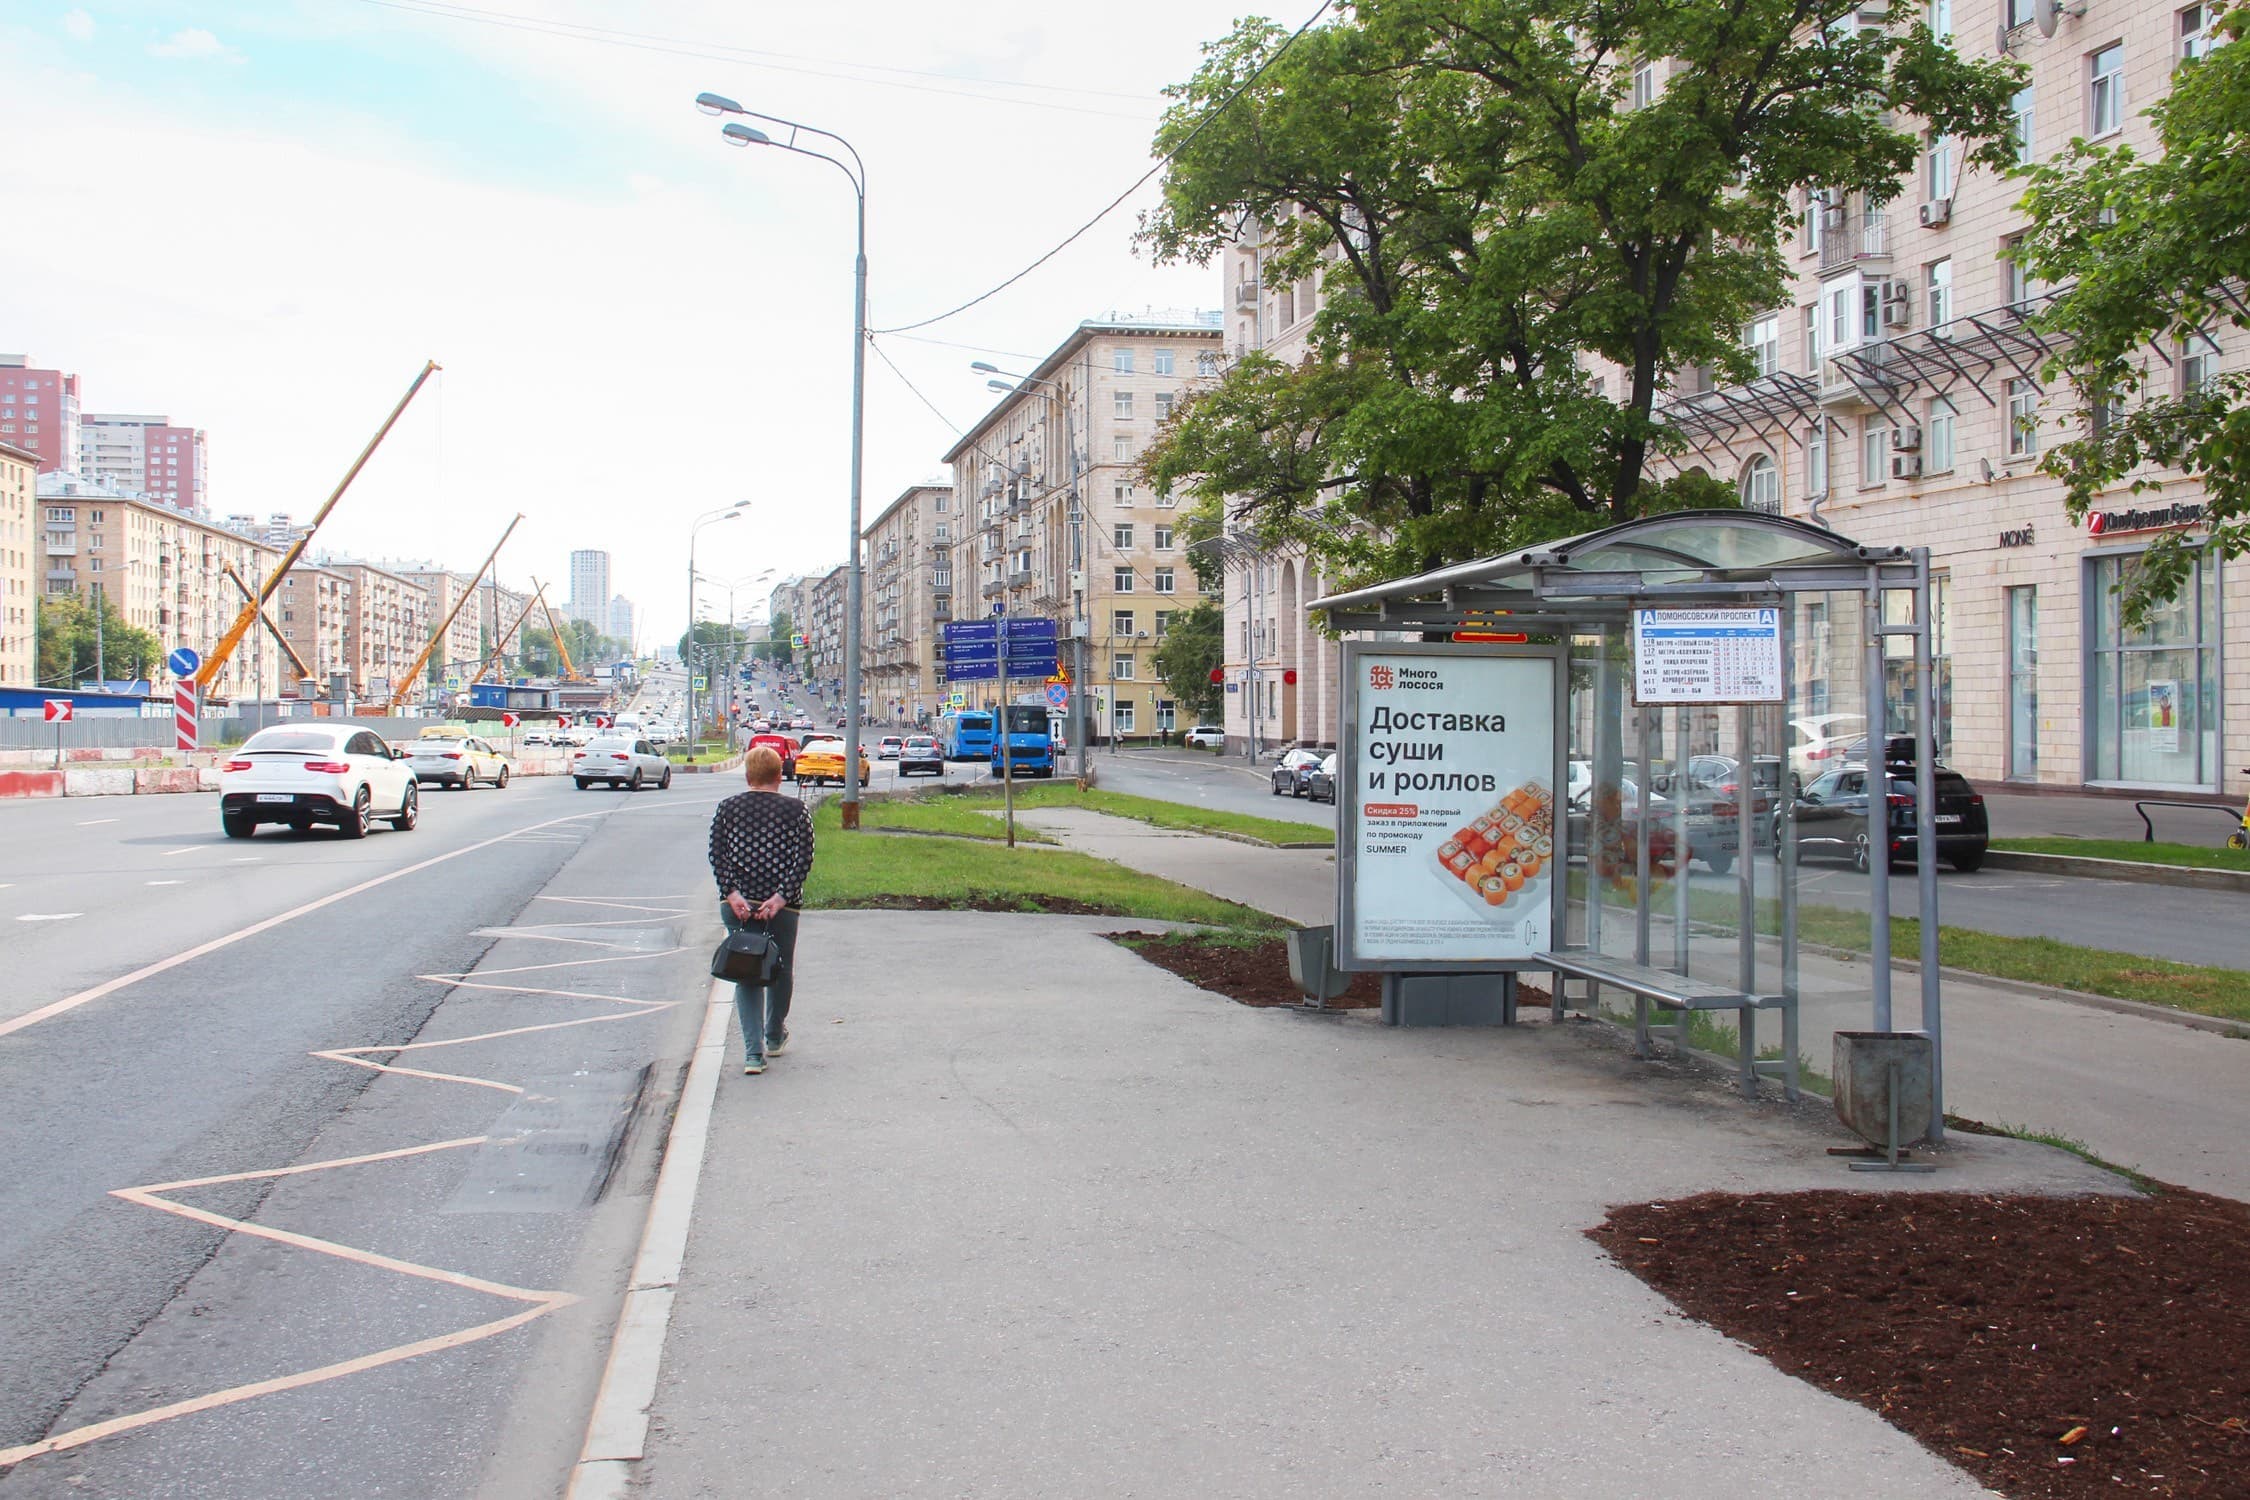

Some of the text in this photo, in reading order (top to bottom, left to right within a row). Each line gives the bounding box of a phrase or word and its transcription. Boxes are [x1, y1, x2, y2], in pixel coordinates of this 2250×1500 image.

[1657, 611, 1718, 621] ЛОМОНОСОВСКИЙ
[1720, 611, 1756, 620] ПРОСПЕКТ
[1399, 667, 1437, 679] Много
[1398, 680, 1444, 690] лосося
[1369, 706, 1505, 734] Доставка
[1369, 741, 1443, 765] суши
[1369, 772, 1496, 796] и роллов
[1367, 806, 1398, 817] Скидка
[1399, 807, 1416, 816] 25%
[1431, 808, 1461, 818] первый
[1397, 820, 1448, 829] приложении
[1378, 832, 1423, 841] промокоду
[1366, 845, 1407, 854] SUMMER
